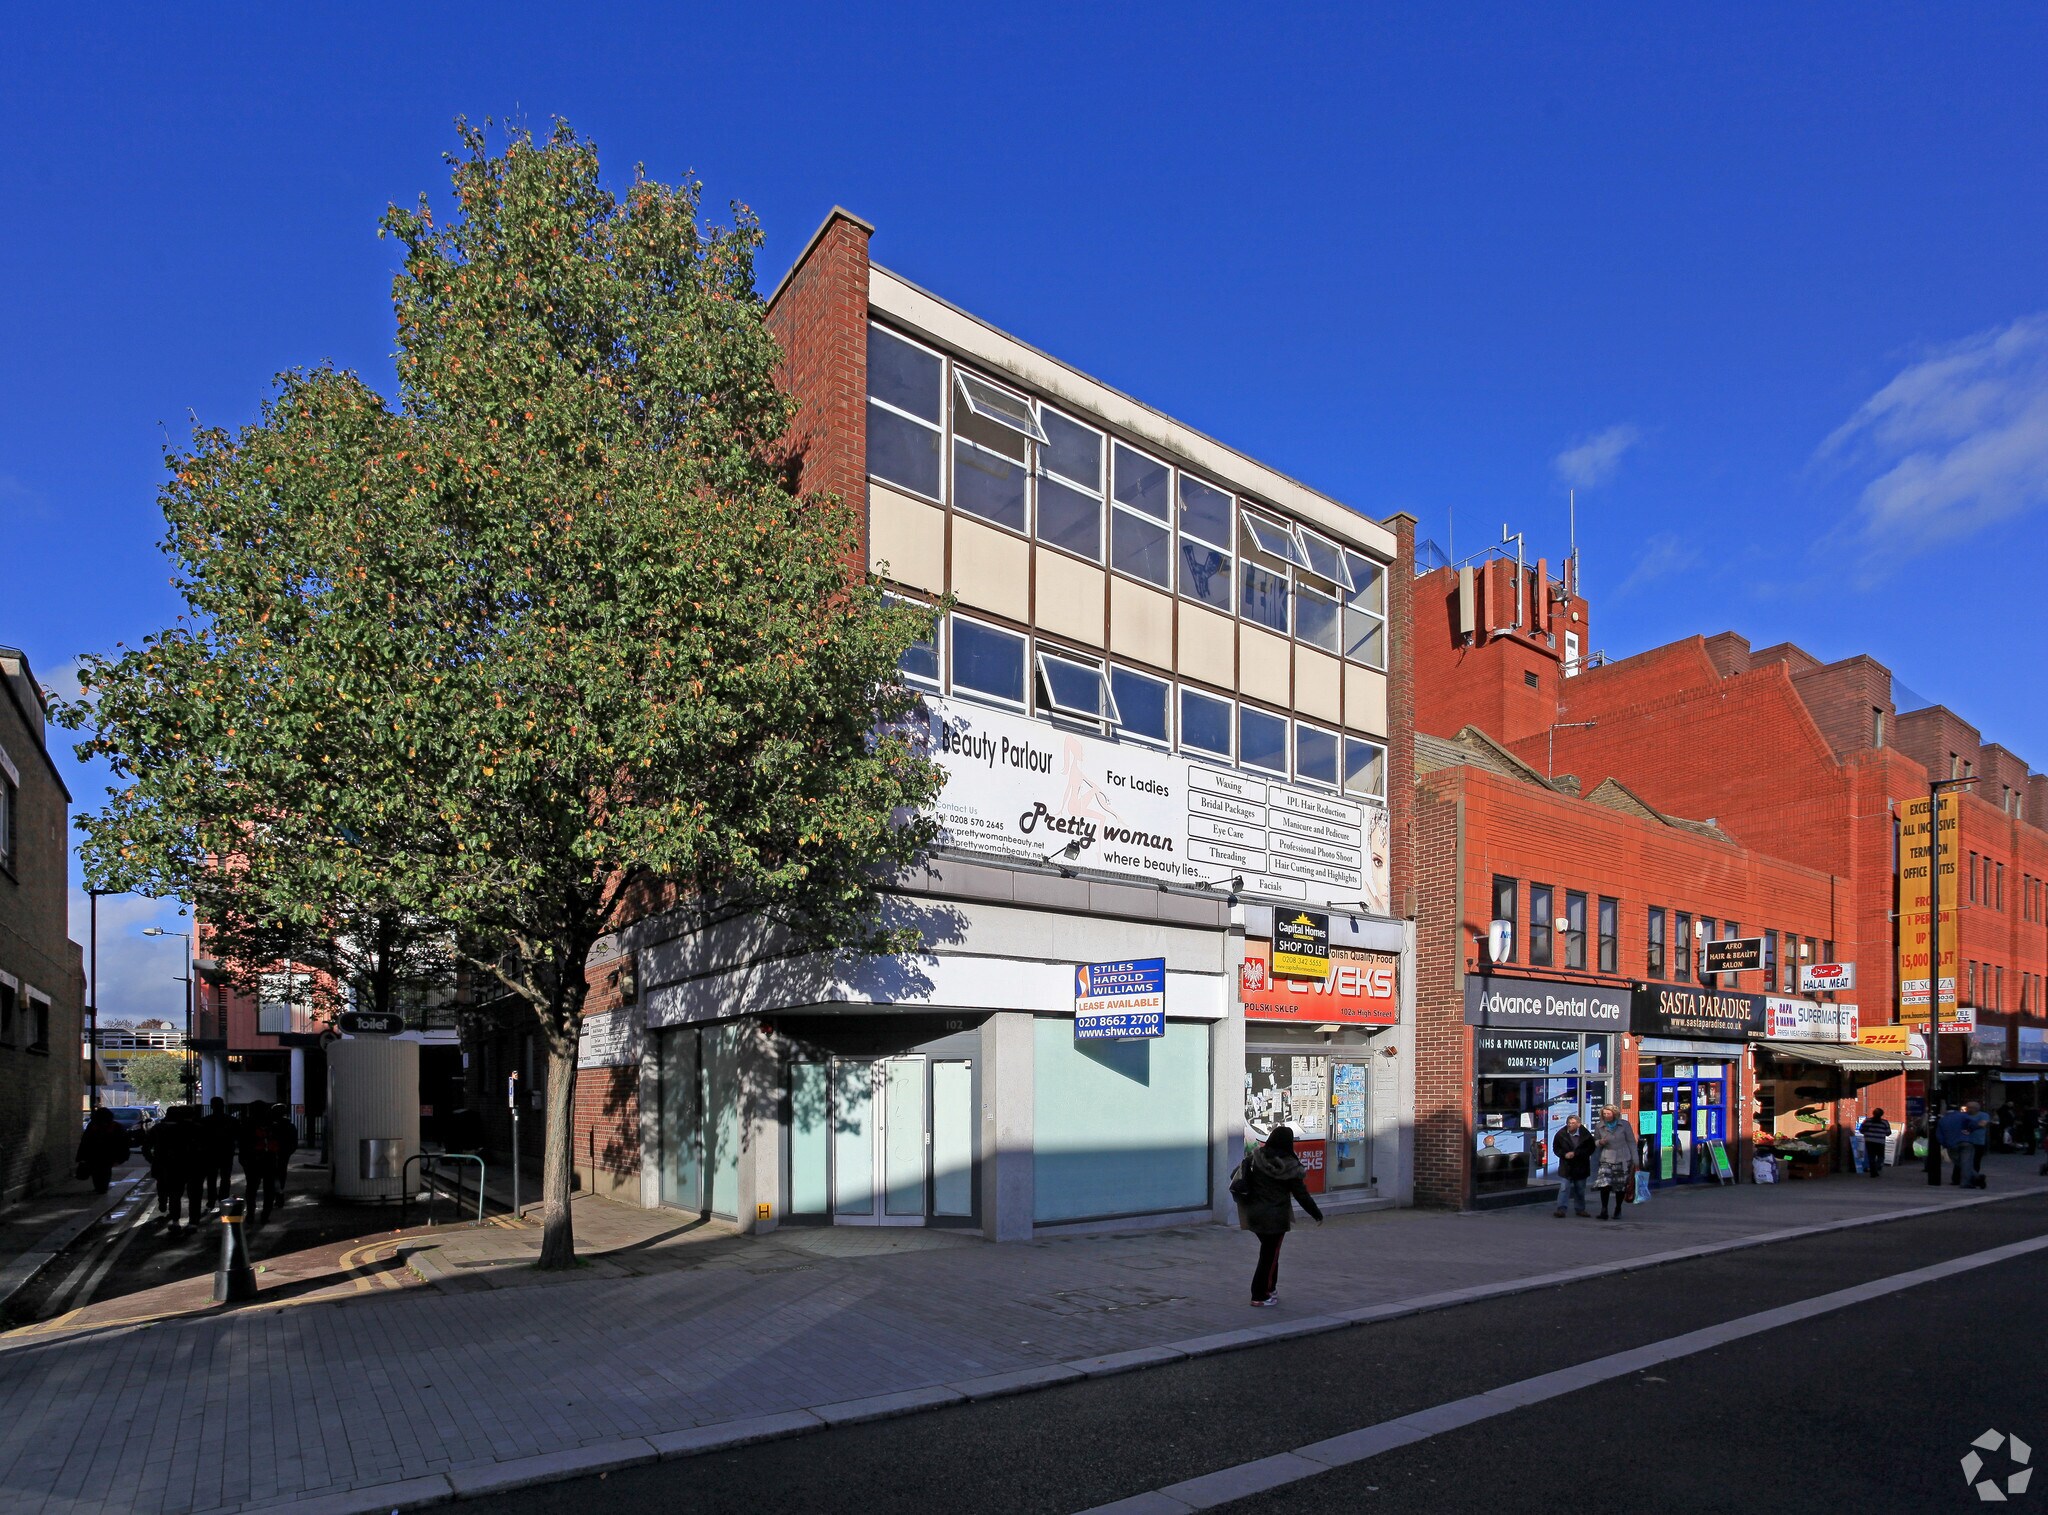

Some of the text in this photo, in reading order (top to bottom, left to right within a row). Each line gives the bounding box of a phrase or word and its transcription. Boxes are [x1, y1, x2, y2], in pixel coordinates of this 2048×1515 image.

[942, 722, 1053, 774] Beauty Parlour
[1107, 770, 1169, 797] For Ladies
[1216, 776, 1242, 794] Waxing
[935, 800, 978, 815] Contact Us
[1201, 797, 1255, 819] Bridal Packages
[1287, 796, 1346, 819] IPL Hair Reduction
[950, 814, 968, 825] 0208
[970, 818, 984, 828] 570
[987, 820, 1004, 831] 2645
[1019, 802, 1174, 852] Pretty woman
[1283, 817, 1350, 841] Manicure and Pedicure
[1903, 818, 1956, 836] ALL INCSIVE
[941, 826, 1045, 850] ww.prettywomanbeauty.net
[1213, 824, 1244, 839] Eye Care
[1209, 846, 1247, 865] Threading
[1279, 839, 1353, 863] Professional Photo Shoot
[1910, 845, 1931, 859] TERM
[1103, 851, 1140, 868] where
[1144, 856, 1181, 877] beauty
[1275, 859, 1357, 883] Hair Cutting and Highlights
[1903, 866, 1927, 879] OFFICE
[1259, 878, 1282, 892] Facials
[1906, 915, 1911, 926] 1
[1278, 921, 1327, 938] Capital Homes
[1501, 930, 1511, 939] NH
[1915, 932, 1926, 944] UP
[1279, 940, 1326, 956] SHOP TO LET
[1725, 942, 1742, 950] AFRO
[1282, 955, 1297, 964] 0208
[1330, 950, 1393, 965] olish Quality Food
[1709, 952, 1725, 960] HAIR
[1732, 950, 1757, 958] BEAUTY
[1901, 952, 1929, 970] 15,000
[1093, 963, 1134, 974] STILES
[1722, 961, 1743, 969] SALON
[1093, 973, 1143, 985] HAROLD
[1267, 965, 1392, 999] WEKS
[1803, 977, 1849, 990] HALAL MEAT
[1903, 981, 1916, 990] DE
[1093, 983, 1153, 995] WILLIAMS
[1079, 998, 1159, 1011] LEASE AVAILABLE
[1244, 1002, 1299, 1013] POLSKI SKLEP
[1479, 991, 1620, 1019] Advance Dental Care
[1660, 990, 1751, 1020] SASTA PARADISE
[1341, 1007, 1392, 1018] 102a High Street
[356, 1017, 389, 1030] toilet
[946, 1020, 964, 1030] 102
[1078, 1014, 1159, 1028] 020 8662 2700
[1670, 1017, 1742, 1031] www.sastaparadise.co.uk
[1078, 1025, 1159, 1038] www.shw.co.uk
[1479, 1039, 1579, 1051] NHS & PRIVATE DENTAL CARE
[1865, 1035, 1898, 1044] DHL
[1507, 1057, 1524, 1067] 0208
[1525, 1057, 1537, 1067] 754
[1303, 1150, 1324, 1158] SKLEP
[758, 1204, 770, 1219] H
